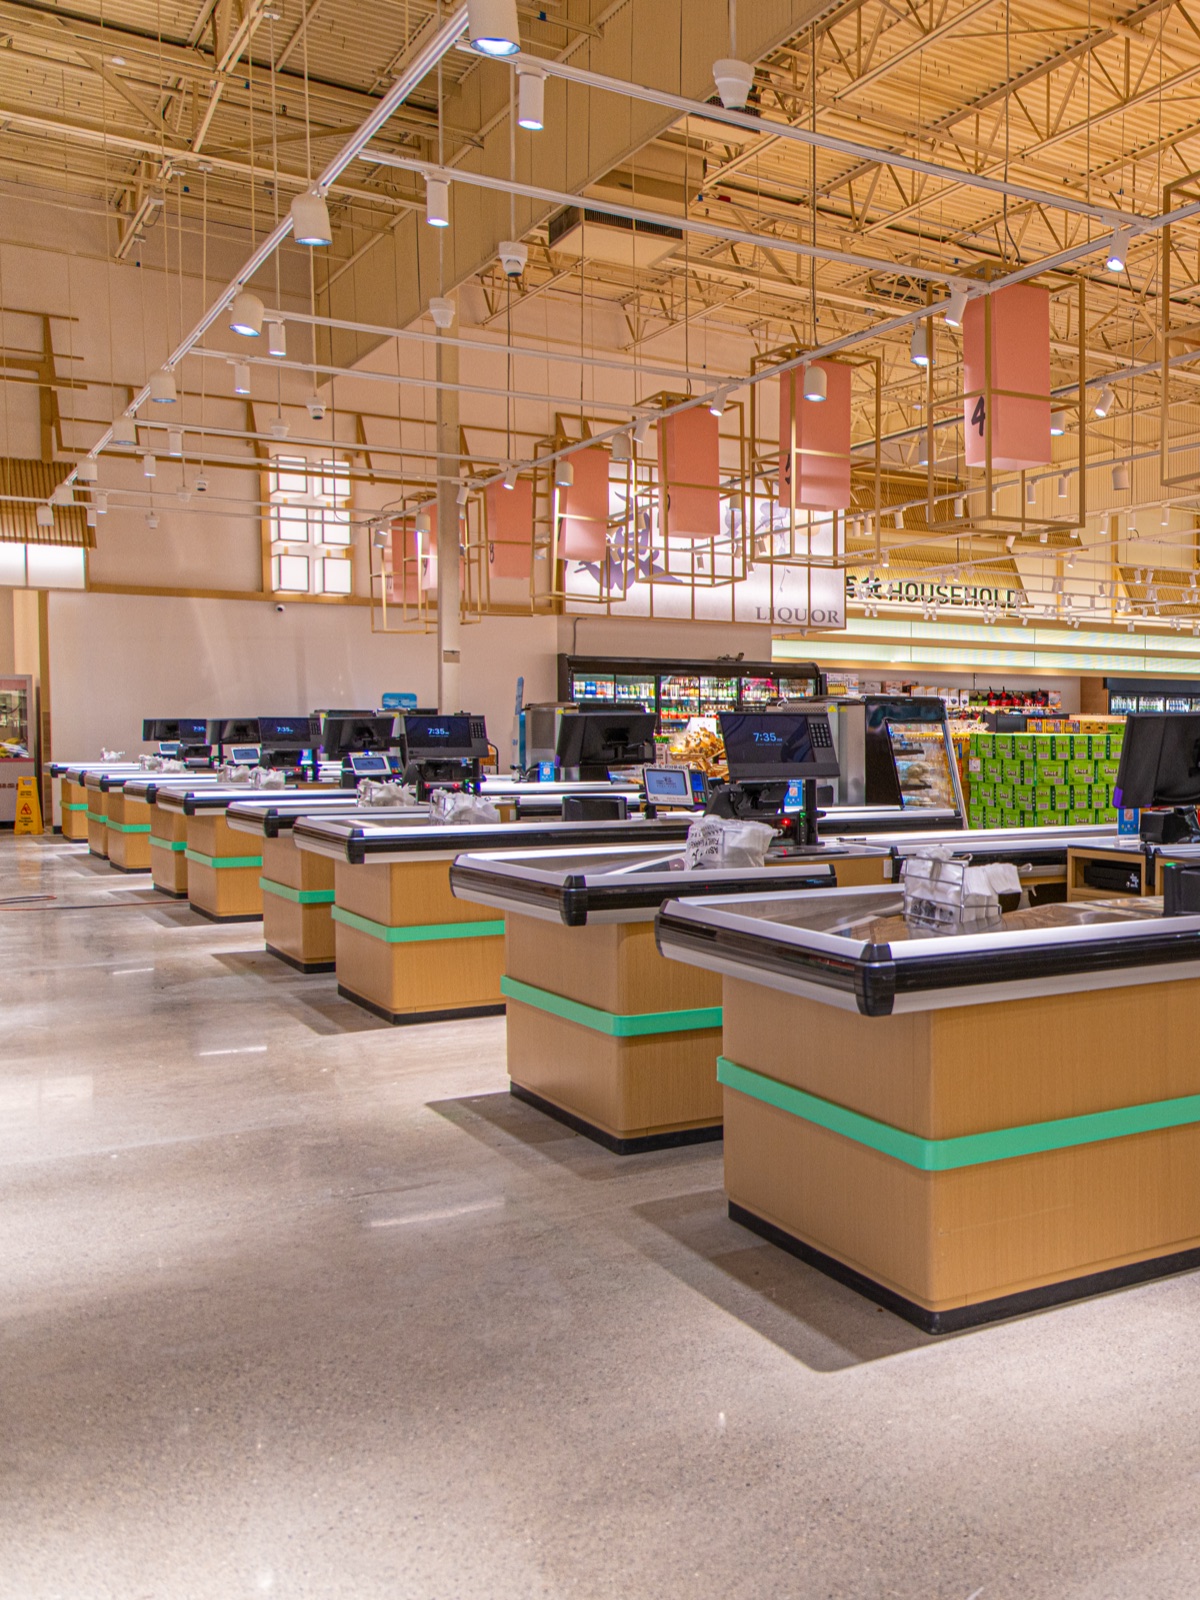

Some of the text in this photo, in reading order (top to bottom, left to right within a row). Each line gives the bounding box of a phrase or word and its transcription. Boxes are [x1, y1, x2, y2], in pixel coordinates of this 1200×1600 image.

[971, 395, 986, 437] 4
[888, 580, 1020, 609] HOUSEHOLD
[756, 605, 840, 624] LIQUOR
[427, 727, 445, 735] 7:35
[753, 732, 777, 742] 7:35
